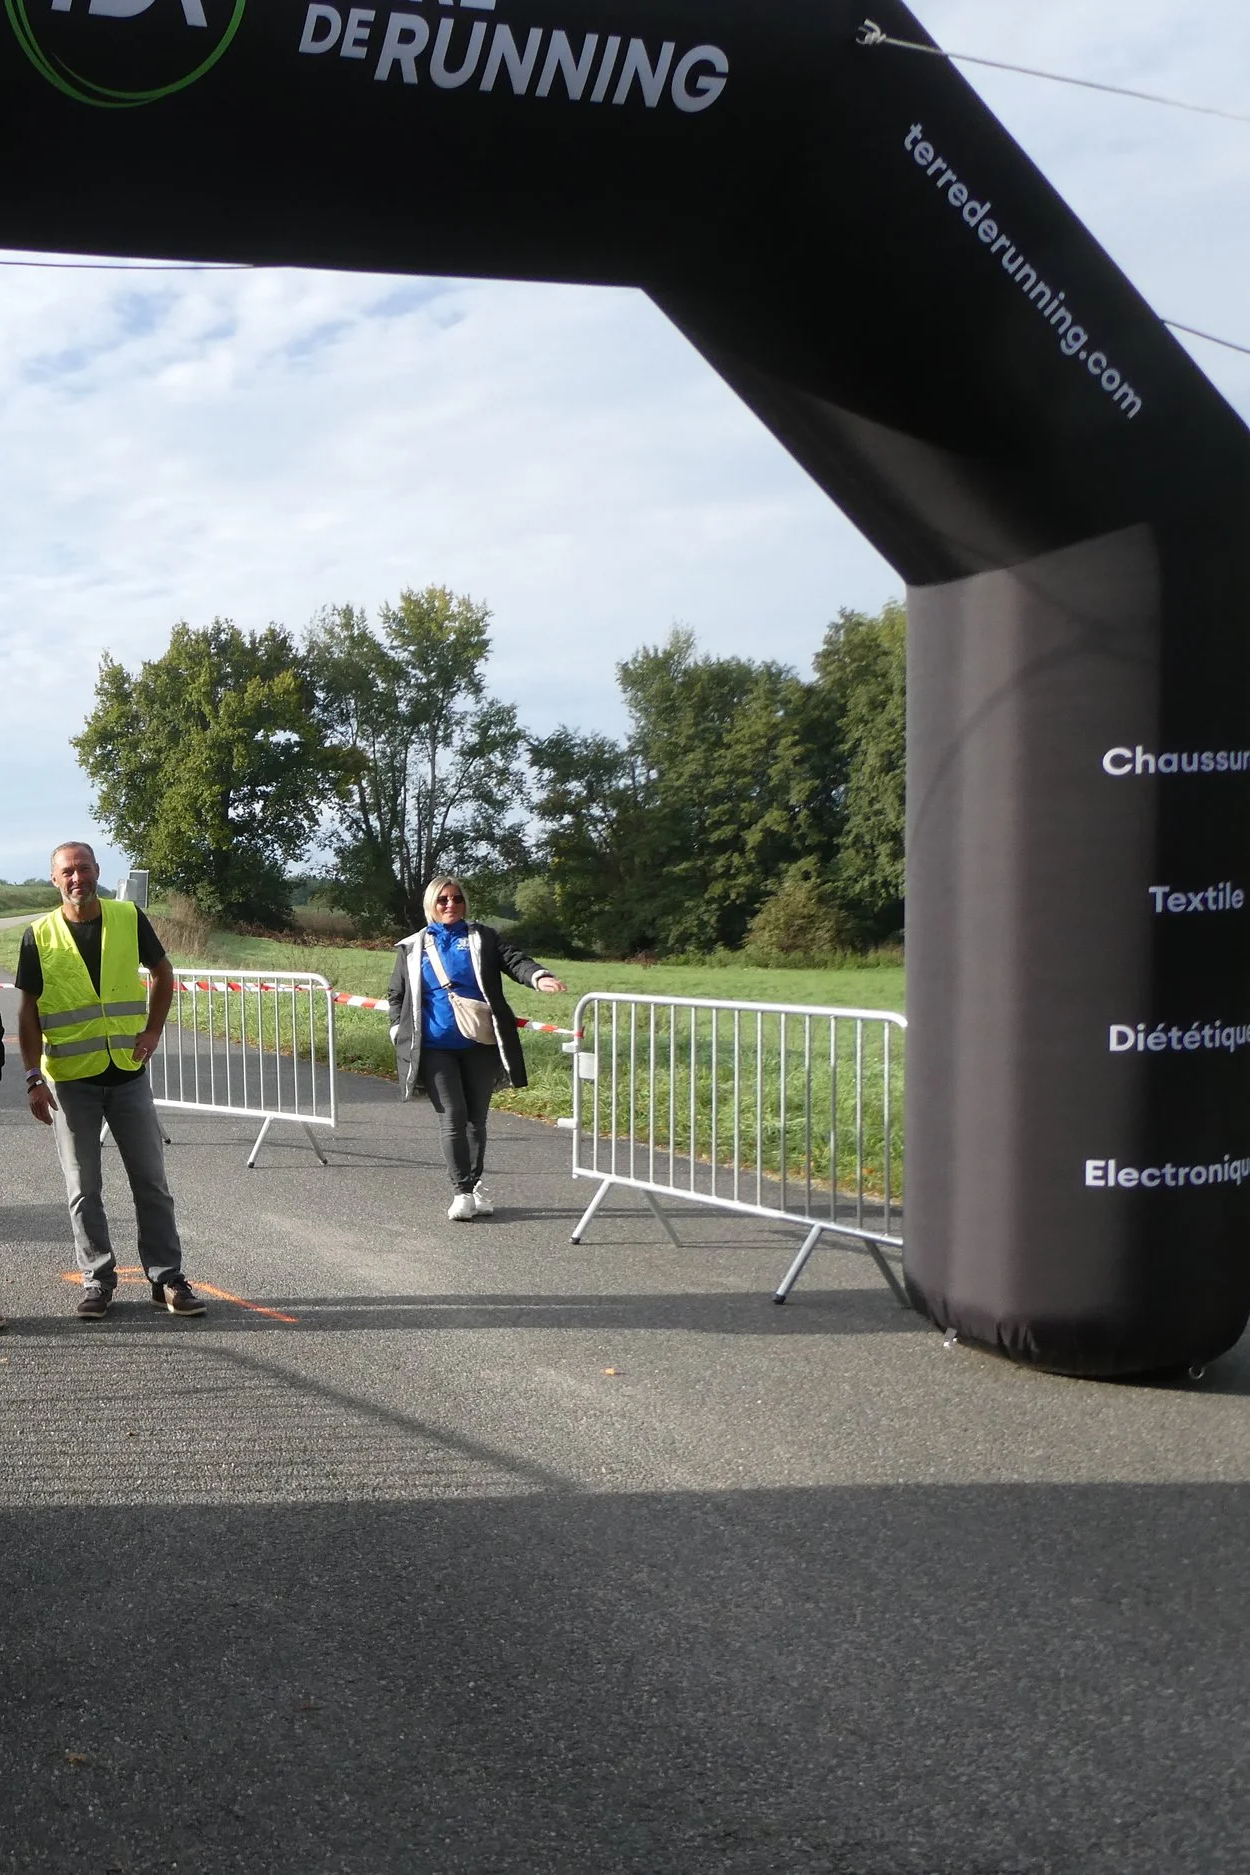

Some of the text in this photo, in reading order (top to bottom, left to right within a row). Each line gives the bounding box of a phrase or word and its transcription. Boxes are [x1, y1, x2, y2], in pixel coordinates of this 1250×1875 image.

[298, 3, 730, 113] DE RUNNING
[903, 122, 1143, 419] terrederunning.com
[1148, 881, 1245, 913] Textile
